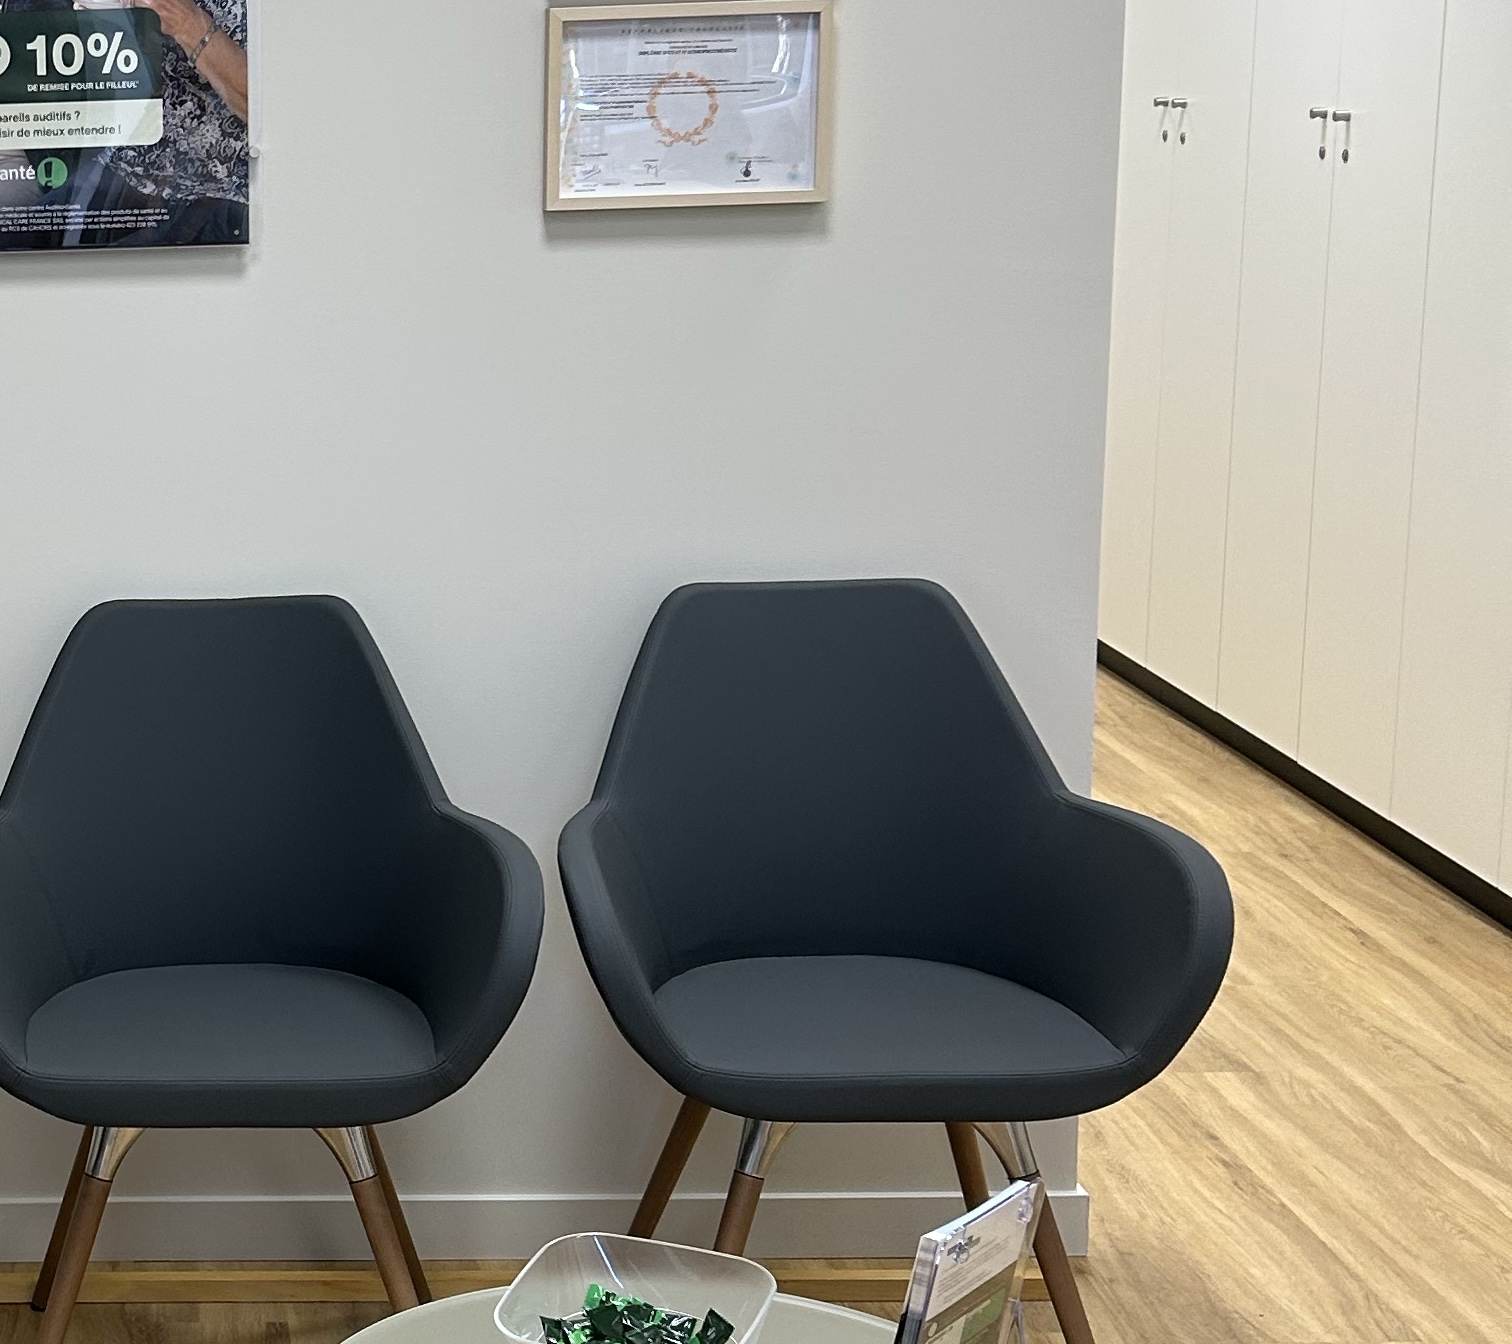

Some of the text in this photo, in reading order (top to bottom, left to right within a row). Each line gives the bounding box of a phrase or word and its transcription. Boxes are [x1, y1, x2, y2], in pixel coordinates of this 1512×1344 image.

[26, 31, 139, 76] 10%
[71, 82, 94, 90] POUR
[33, 111, 72, 122] auditifs
[74, 110, 81, 121] ?
[16, 127, 30, 137] de
[33, 126, 66, 137] mieux
[68, 124, 116, 136] entendre
